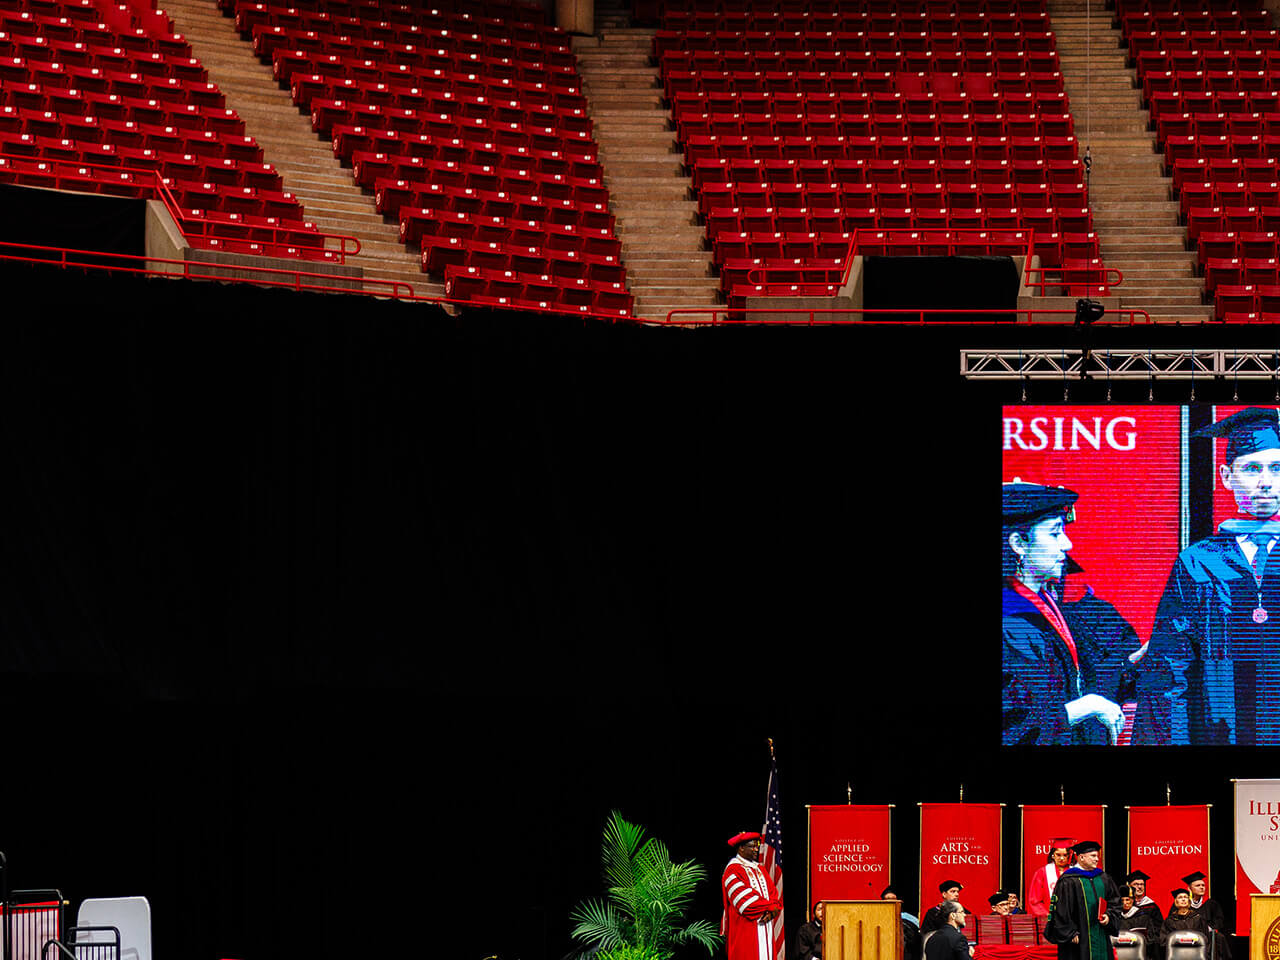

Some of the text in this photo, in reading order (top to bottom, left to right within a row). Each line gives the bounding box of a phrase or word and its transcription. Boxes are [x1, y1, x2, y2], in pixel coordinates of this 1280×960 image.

[1002, 416, 1138, 451] RSING
[830, 844, 870, 853] APPLIED
[940, 842, 969, 853] ARTS
[1137, 844, 1202, 856] EDUCATION
[823, 853, 864, 862] SCIENCE
[932, 854, 989, 865] SCIENCES
[817, 863, 883, 872] TECHNOLOGY
